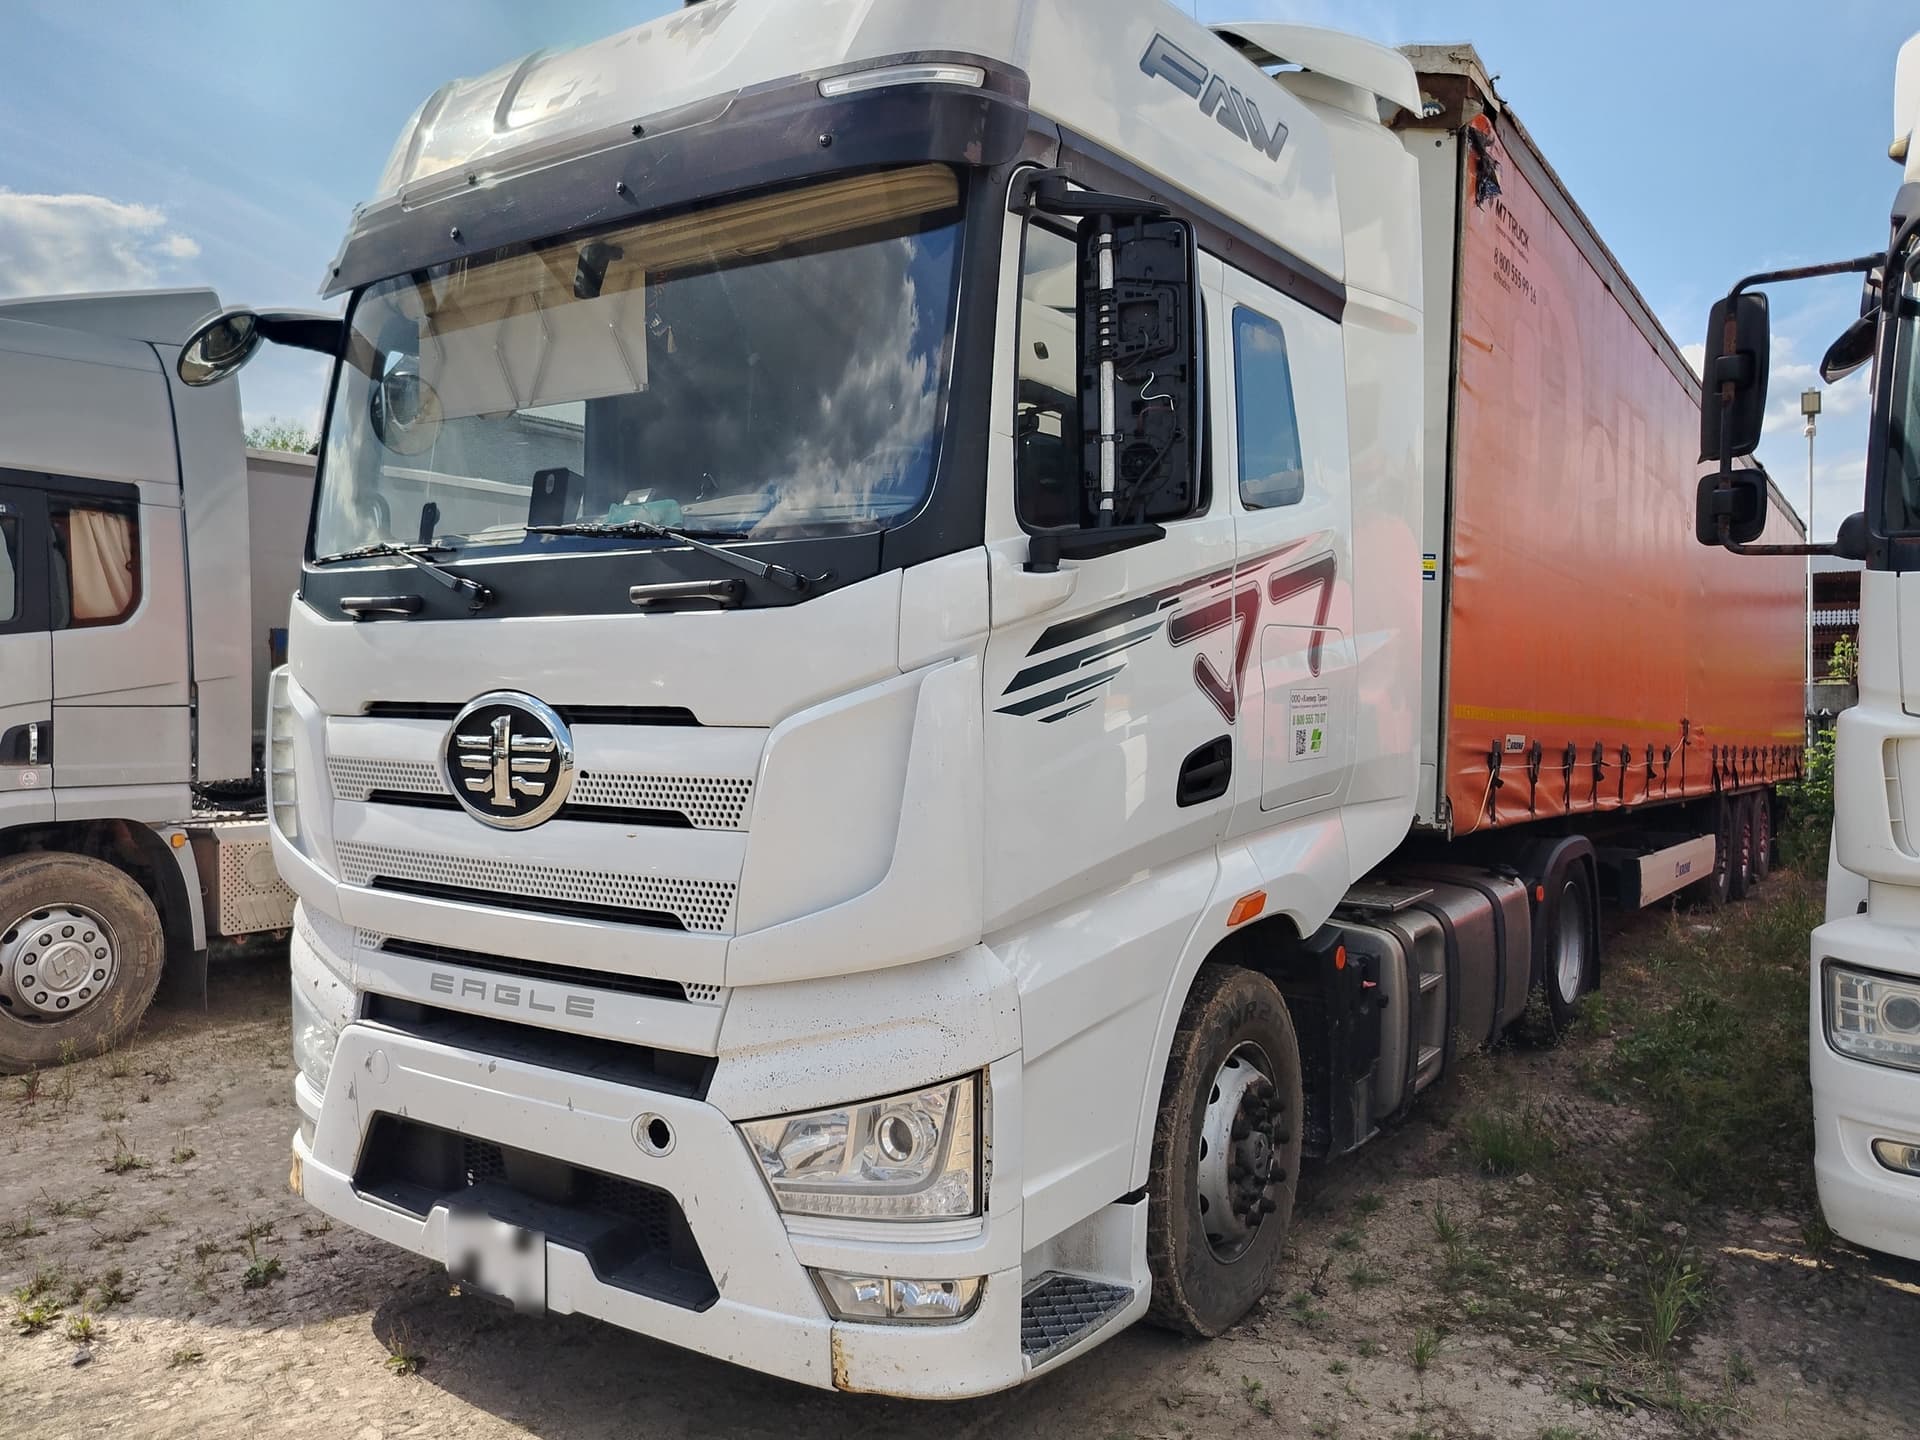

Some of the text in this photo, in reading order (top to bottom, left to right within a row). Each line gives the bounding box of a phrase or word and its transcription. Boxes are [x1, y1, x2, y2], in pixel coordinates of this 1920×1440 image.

[1139, 33, 1289, 163] FAW
[1495, 198, 1507, 223] M7
[1507, 210, 1529, 252] TRUCK
[1494, 247, 1499, 265] 8
[1499, 252, 1511, 277] 800
[1511, 264, 1522, 289] 555
[430, 972, 595, 1018] EAGLE
